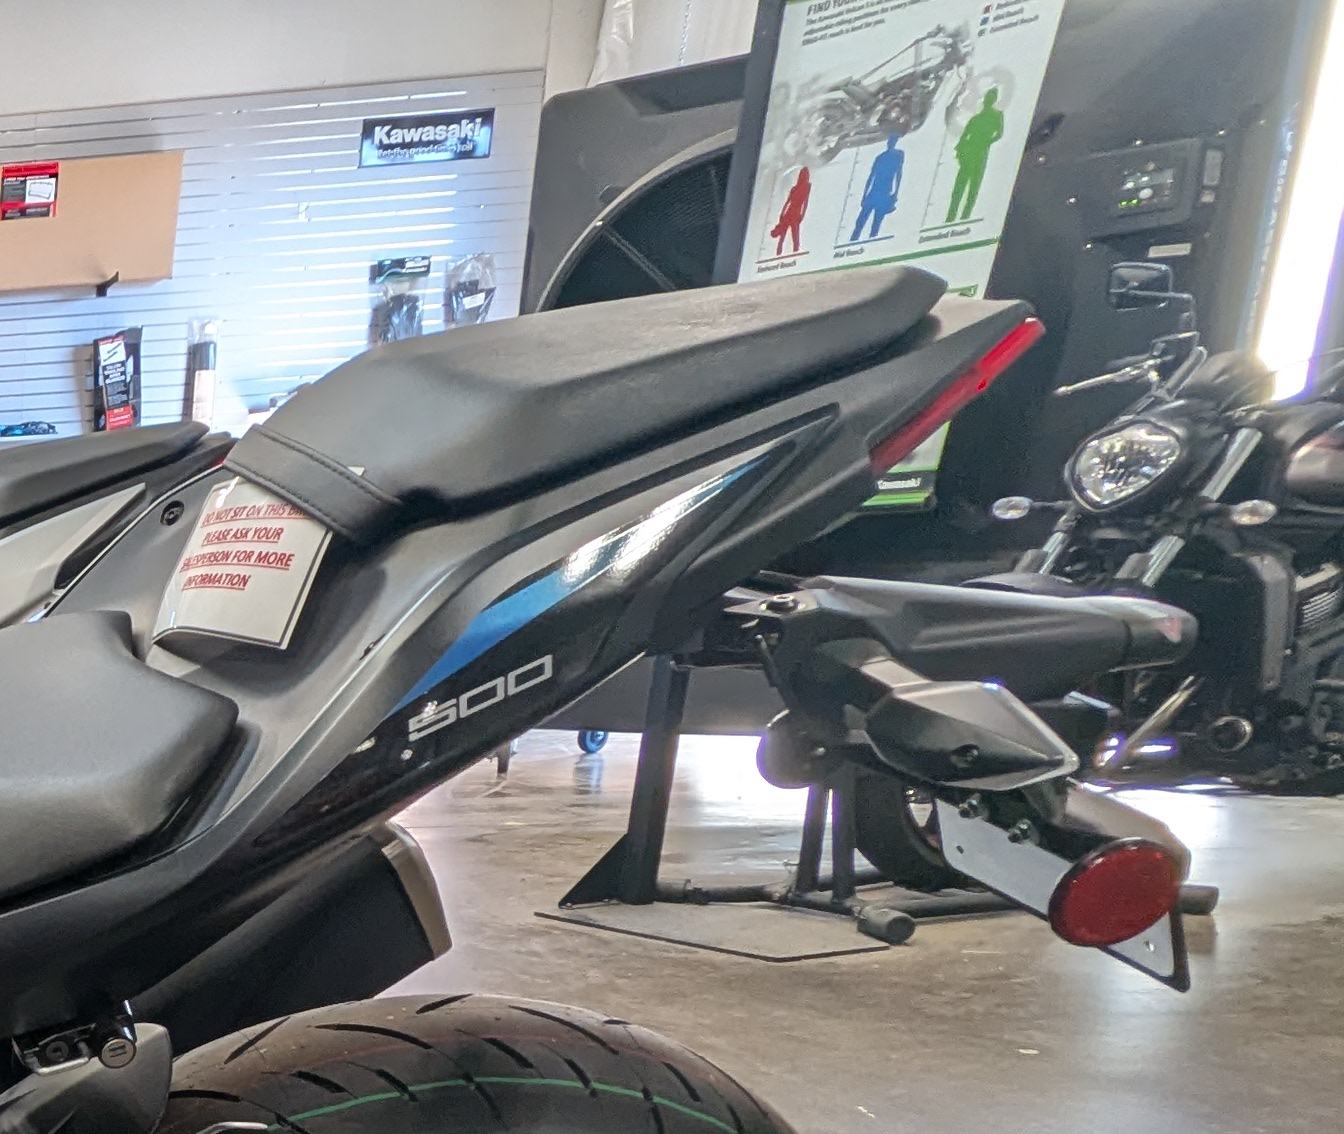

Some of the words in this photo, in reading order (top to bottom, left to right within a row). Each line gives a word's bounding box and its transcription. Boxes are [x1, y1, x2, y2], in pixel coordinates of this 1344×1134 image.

[373, 117, 483, 145] Kawasaki
[213, 508, 231, 522] NOT
[246, 504, 263, 518] ON
[264, 503, 287, 516] THIS
[203, 528, 232, 543] PLEASE
[231, 527, 252, 540] ASK
[252, 527, 285, 541] YOUR
[231, 550, 255, 563] FOR
[254, 551, 295, 567] MORE
[183, 572, 252, 588] INFORMATION
[408, 654, 554, 742] 500
